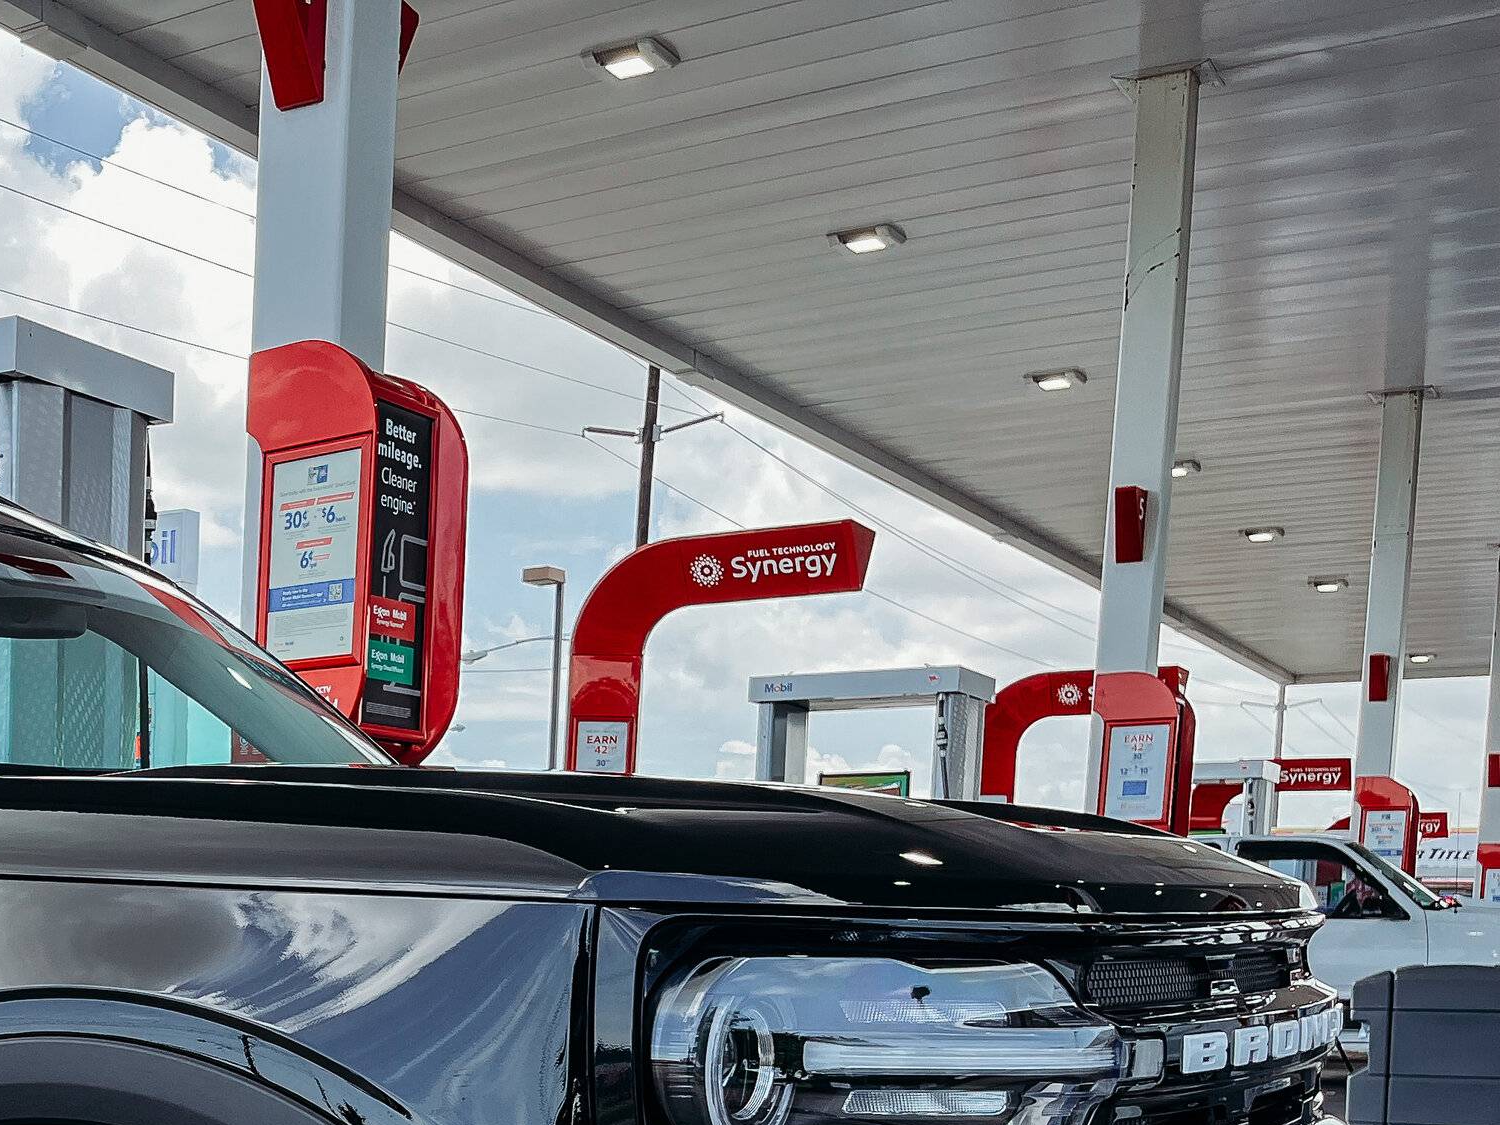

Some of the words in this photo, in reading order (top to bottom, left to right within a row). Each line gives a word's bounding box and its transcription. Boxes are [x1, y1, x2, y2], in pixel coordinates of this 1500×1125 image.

[385, 418, 417, 444] Better
[378, 441, 422, 470] mileage.
[381, 466, 418, 493] Cleaner
[747, 549, 771, 558] FUEL
[772, 542, 836, 555] TECHNOLOGY
[731, 553, 837, 583] Synergy
[373, 605, 390, 618] Exxon
[392, 608, 407, 621] Mobil
[371, 649, 388, 662] Exxon
[390, 652, 405, 664] Mobil
[764, 683, 793, 693] Mobil
[586, 735, 618, 744] EARN
[1124, 734, 1154, 743] EARN
[595, 746, 608, 754] 42
[1280, 769, 1342, 785] Synergy
